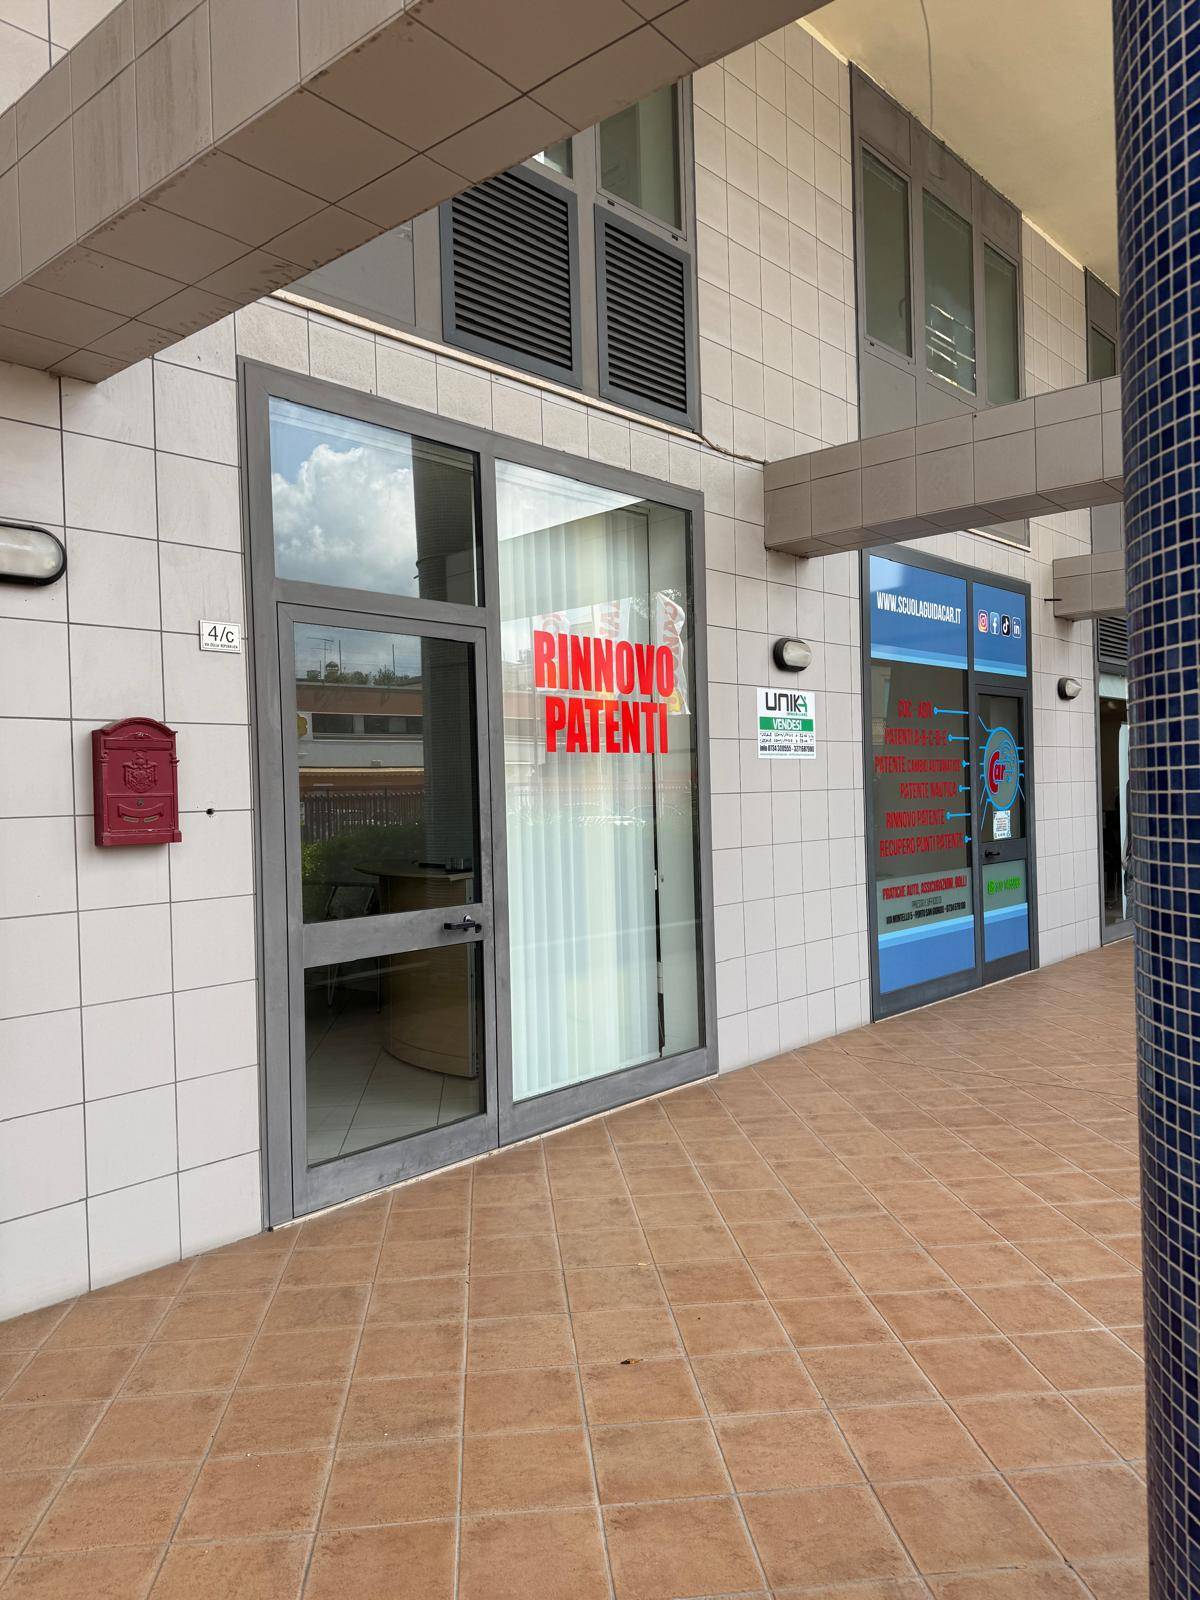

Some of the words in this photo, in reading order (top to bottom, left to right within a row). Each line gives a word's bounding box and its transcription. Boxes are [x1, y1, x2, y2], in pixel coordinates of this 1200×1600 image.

[877, 592, 961, 624] WWW.SCUOLAGUIDACAR.IT
[208, 625, 234, 643] 4/c
[533, 630, 675, 697] RINNOVO
[545, 696, 669, 754] PATENTI
[773, 718, 802, 731] VENDESI
[874, 755, 905, 773] PATENTE
[899, 782, 929, 799] PATENTE
[886, 810, 916, 829] RINNOVO
[917, 808, 945, 826] PATENTE
[880, 837, 915, 857] RECUPERO
